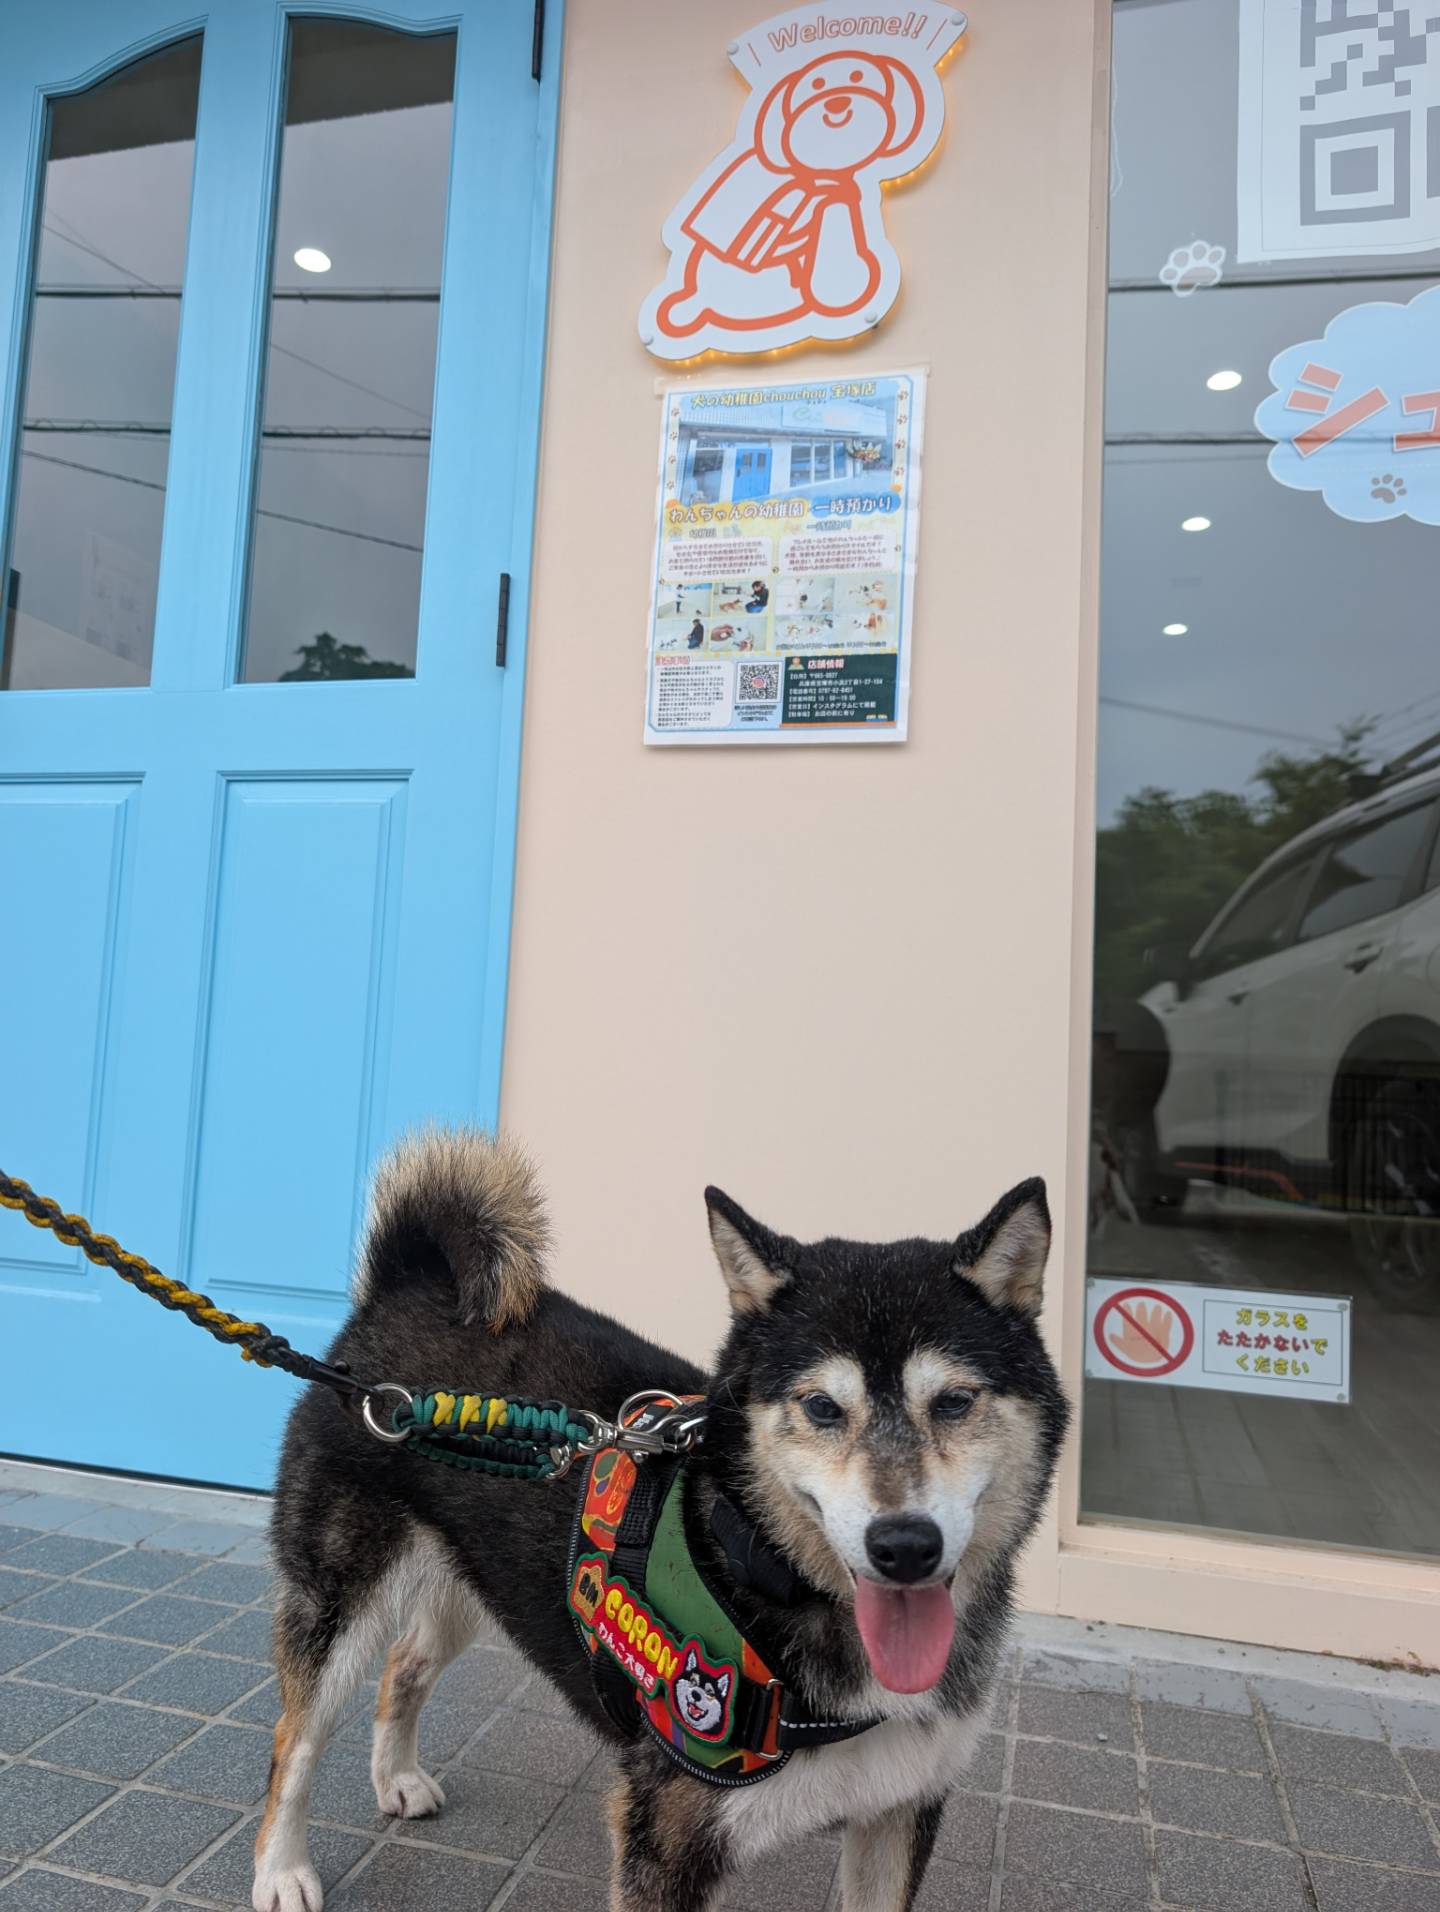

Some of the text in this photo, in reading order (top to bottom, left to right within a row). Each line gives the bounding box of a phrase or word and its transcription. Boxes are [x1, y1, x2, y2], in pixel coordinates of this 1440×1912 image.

[768, 12, 928, 52] Welcome!!
[669, 495, 893, 524] わんちゃんの幼稚園 一時預かり
[1236, 1308, 1309, 1331] ガラスを
[1217, 1329, 1329, 1356] たたかないで
[1236, 1353, 1310, 1376] ください
[605, 1588, 679, 1680] CORON
